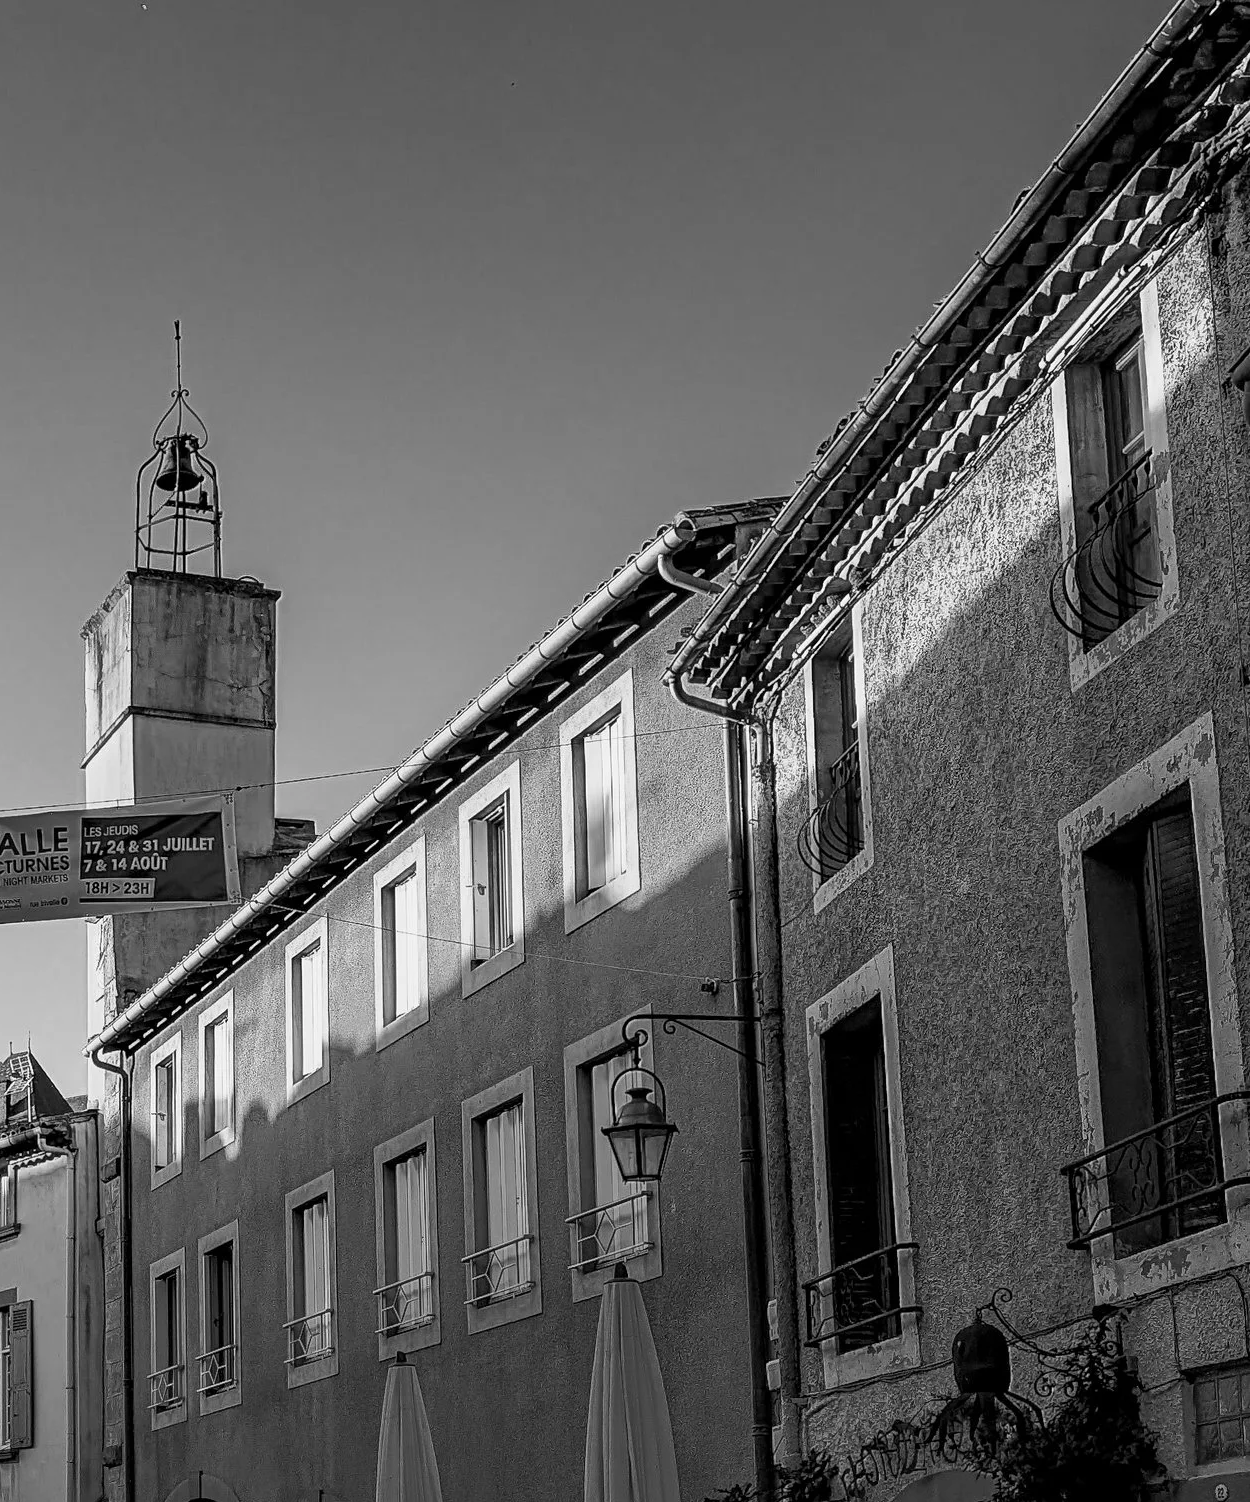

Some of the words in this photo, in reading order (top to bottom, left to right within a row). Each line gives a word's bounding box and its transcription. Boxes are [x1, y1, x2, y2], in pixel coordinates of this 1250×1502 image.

[84, 827, 102, 838] LES
[103, 825, 139, 837] JEUDIS
[106, 840, 126, 854] 24
[129, 840, 140, 853] &
[142, 839, 159, 852] 31
[163, 837, 215, 851] JUILLET
[83, 859, 93, 873] 7
[95, 859, 107, 872] &
[111, 858, 127, 871] 14
[130, 853, 169, 871] AOÛT
[3, 876, 29, 887] NIGHT
[30, 873, 69, 885] MARKETS
[85, 882, 109, 894] 18H
[124, 882, 149, 894] 23H
